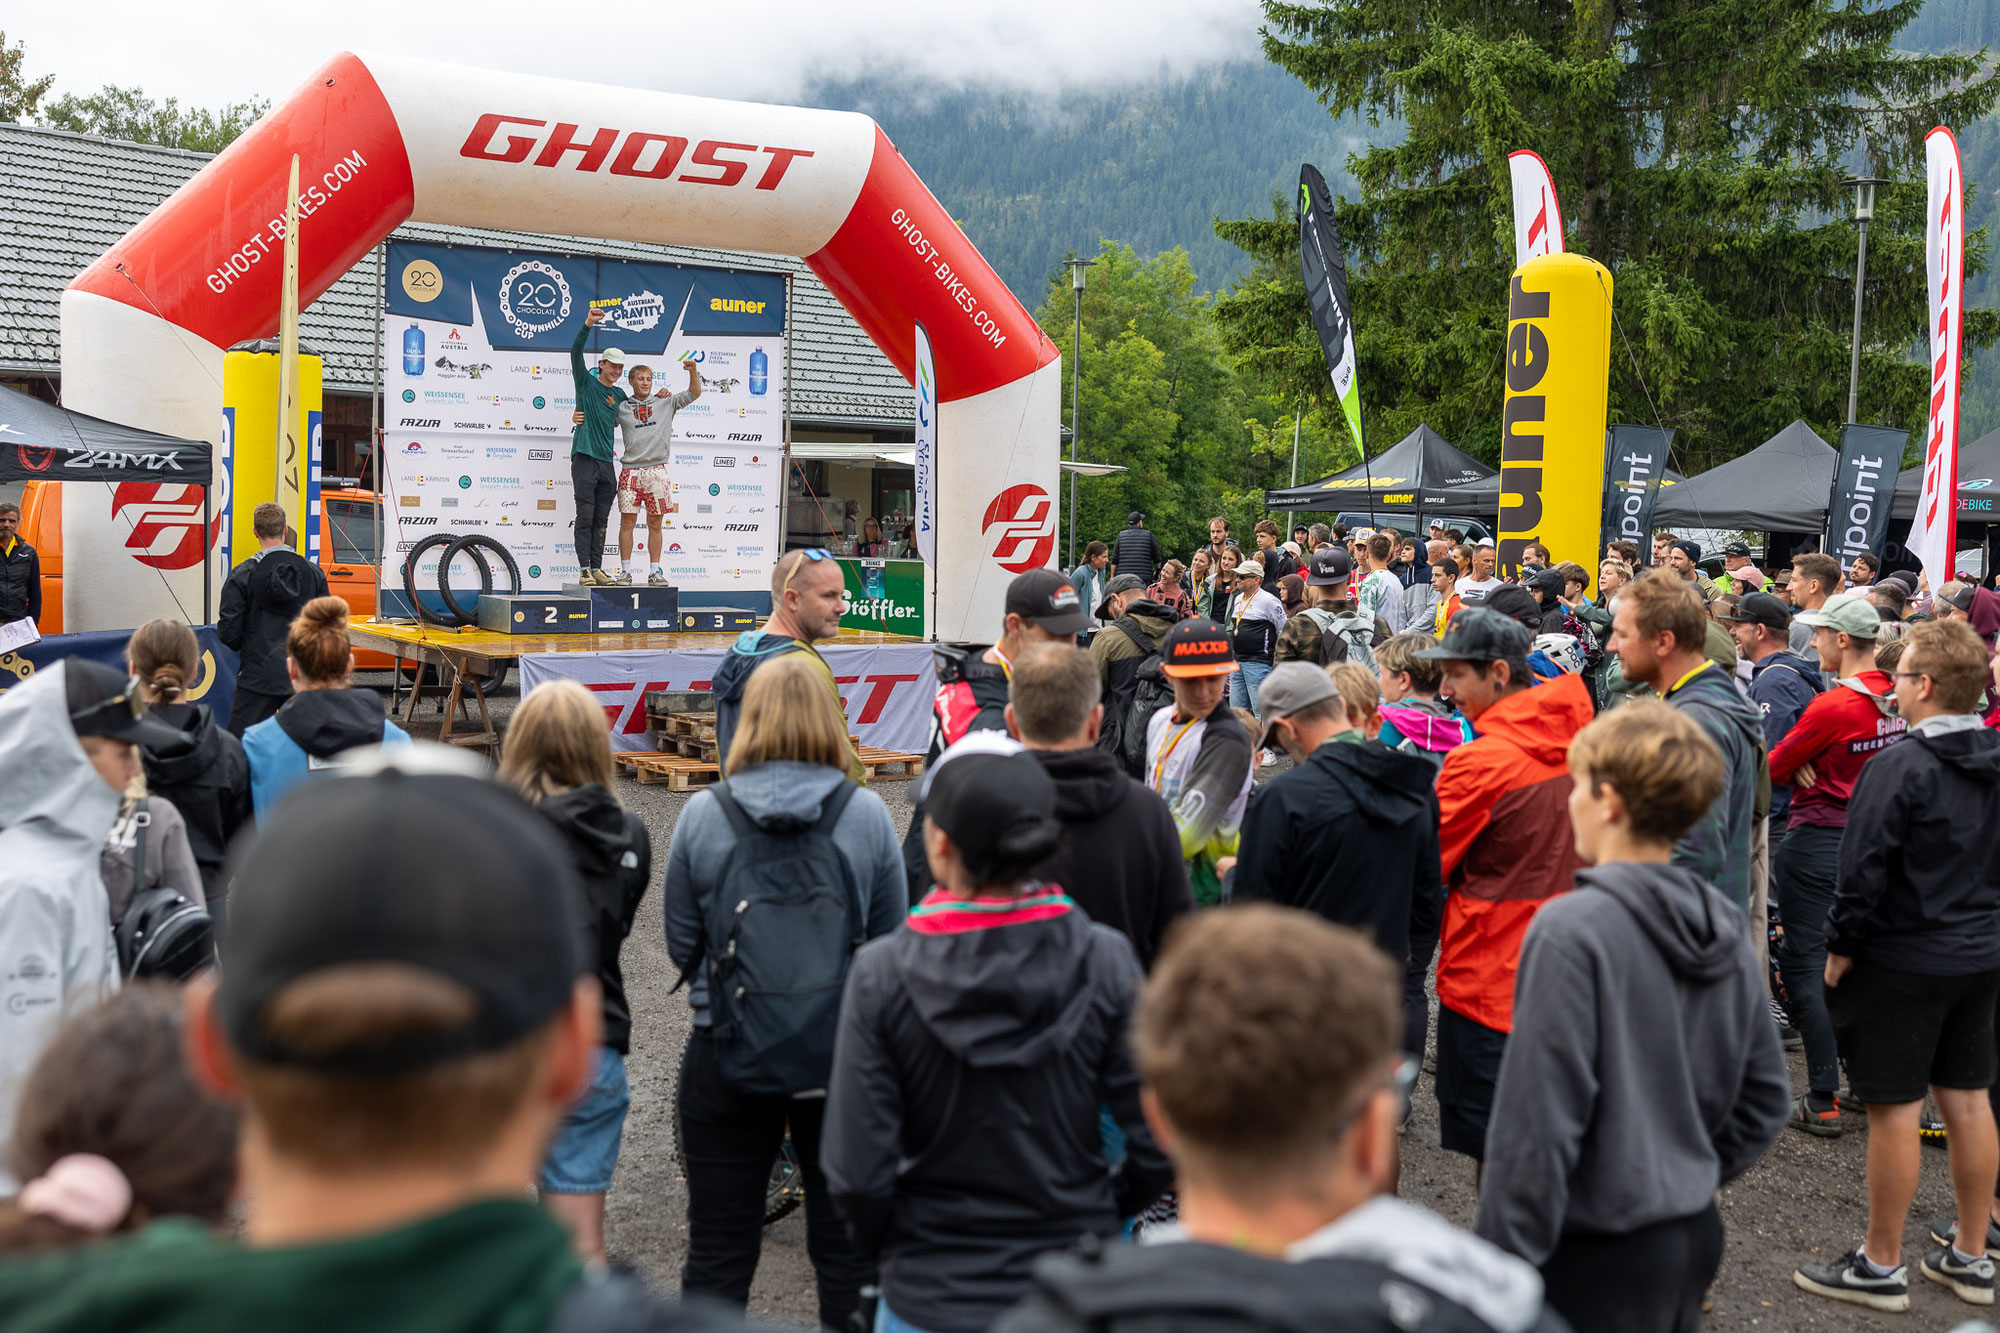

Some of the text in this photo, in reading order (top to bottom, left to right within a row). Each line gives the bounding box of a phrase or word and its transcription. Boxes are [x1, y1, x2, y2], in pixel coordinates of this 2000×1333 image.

[459, 113, 815, 191] GHOST
[206, 149, 367, 294] GHOST-BES.COM
[410, 270, 437, 287] 20
[891, 208, 1006, 349] GHOST-BIKES.COM
[517, 281, 557, 308] 20
[627, 298, 655, 306] AUSTRIAN
[516, 306, 557, 316] CHOCOLATE
[589, 297, 622, 309] auner
[710, 297, 766, 314] auner
[612, 304, 661, 321] GRAVITY
[514, 315, 565, 333] DOWNHILL
[627, 319, 645, 327] SERIES
[514, 327, 534, 340] CUP
[543, 368, 572, 376] KÄRNTEN
[424, 390, 466, 399] WEISSENSEE
[63, 448, 184, 471] 24MX
[530, 452, 550, 460] LINES
[716, 458, 734, 466] LINES
[1321, 477, 1408, 489] auner
[1383, 494, 1414, 504] auner
[1615, 452, 1652, 545] ipoint
[1956, 499, 1992, 510] DEBIKE
[631, 593, 640, 610] 1
[840, 589, 916, 620] Stöffler
[544, 606, 558, 624] 2
[714, 614, 724, 628] 3
[1174, 640, 1228, 656] MAXXIS
[1564, 646, 1581, 669] POC
[1876, 717, 1907, 736] COACH
[1852, 738, 1884, 752] KEEN
